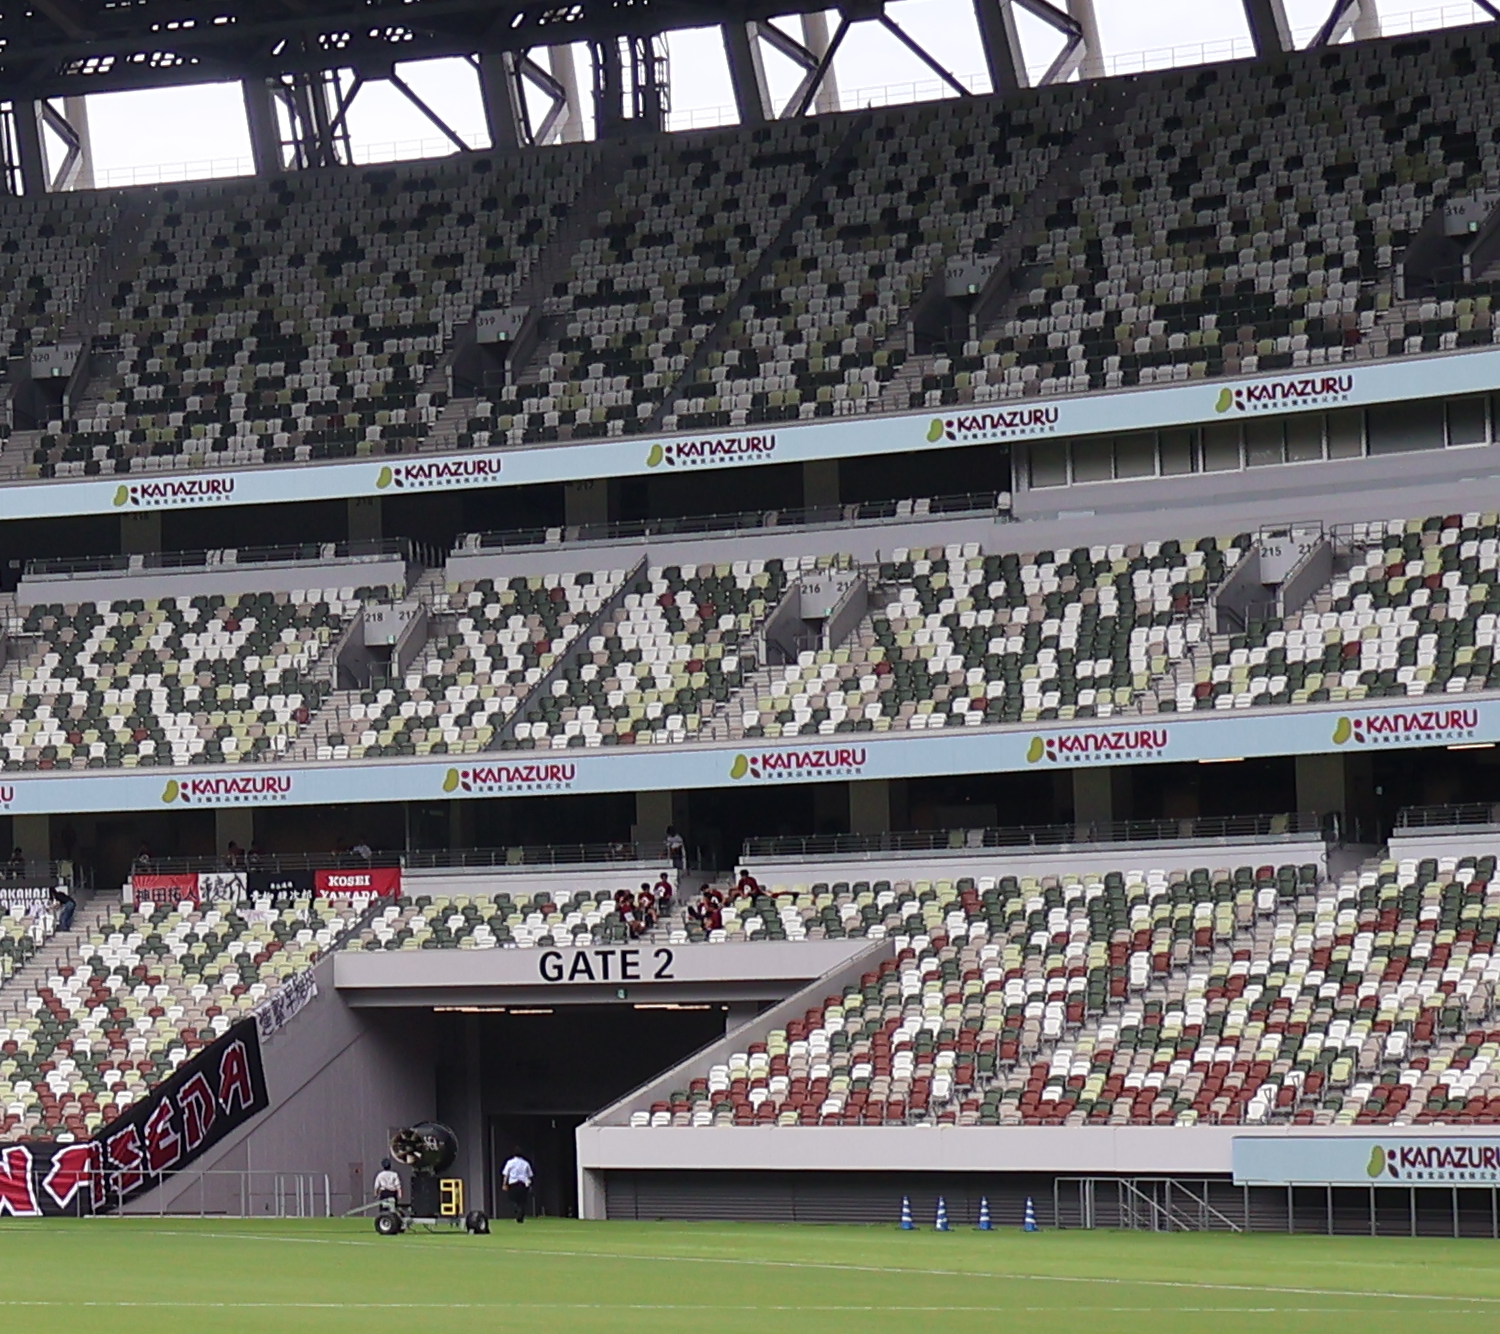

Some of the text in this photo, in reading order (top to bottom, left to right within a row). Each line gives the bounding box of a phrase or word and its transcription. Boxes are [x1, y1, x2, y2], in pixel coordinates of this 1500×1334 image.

[511, 314, 525, 323] 31
[1246, 375, 1352, 401] KANAZURU
[957, 408, 1058, 432] KANAZURU
[675, 434, 776, 456] KANAZURU
[404, 458, 502, 482] KANAZURU
[140, 478, 234, 498] KANAZURU
[1261, 547, 1282, 557] 215
[802, 584, 820, 595] 216
[364, 612, 383, 623] 218
[1367, 709, 1477, 734] KANAZURU
[1058, 729, 1167, 753] KANAZURU
[762, 748, 866, 770] KANAZURU
[473, 764, 575, 784] KANAZURU
[192, 776, 290, 795] KANAZURU
[328, 875, 370, 887] KOSEI
[539, 948, 674, 983] GATE 2
